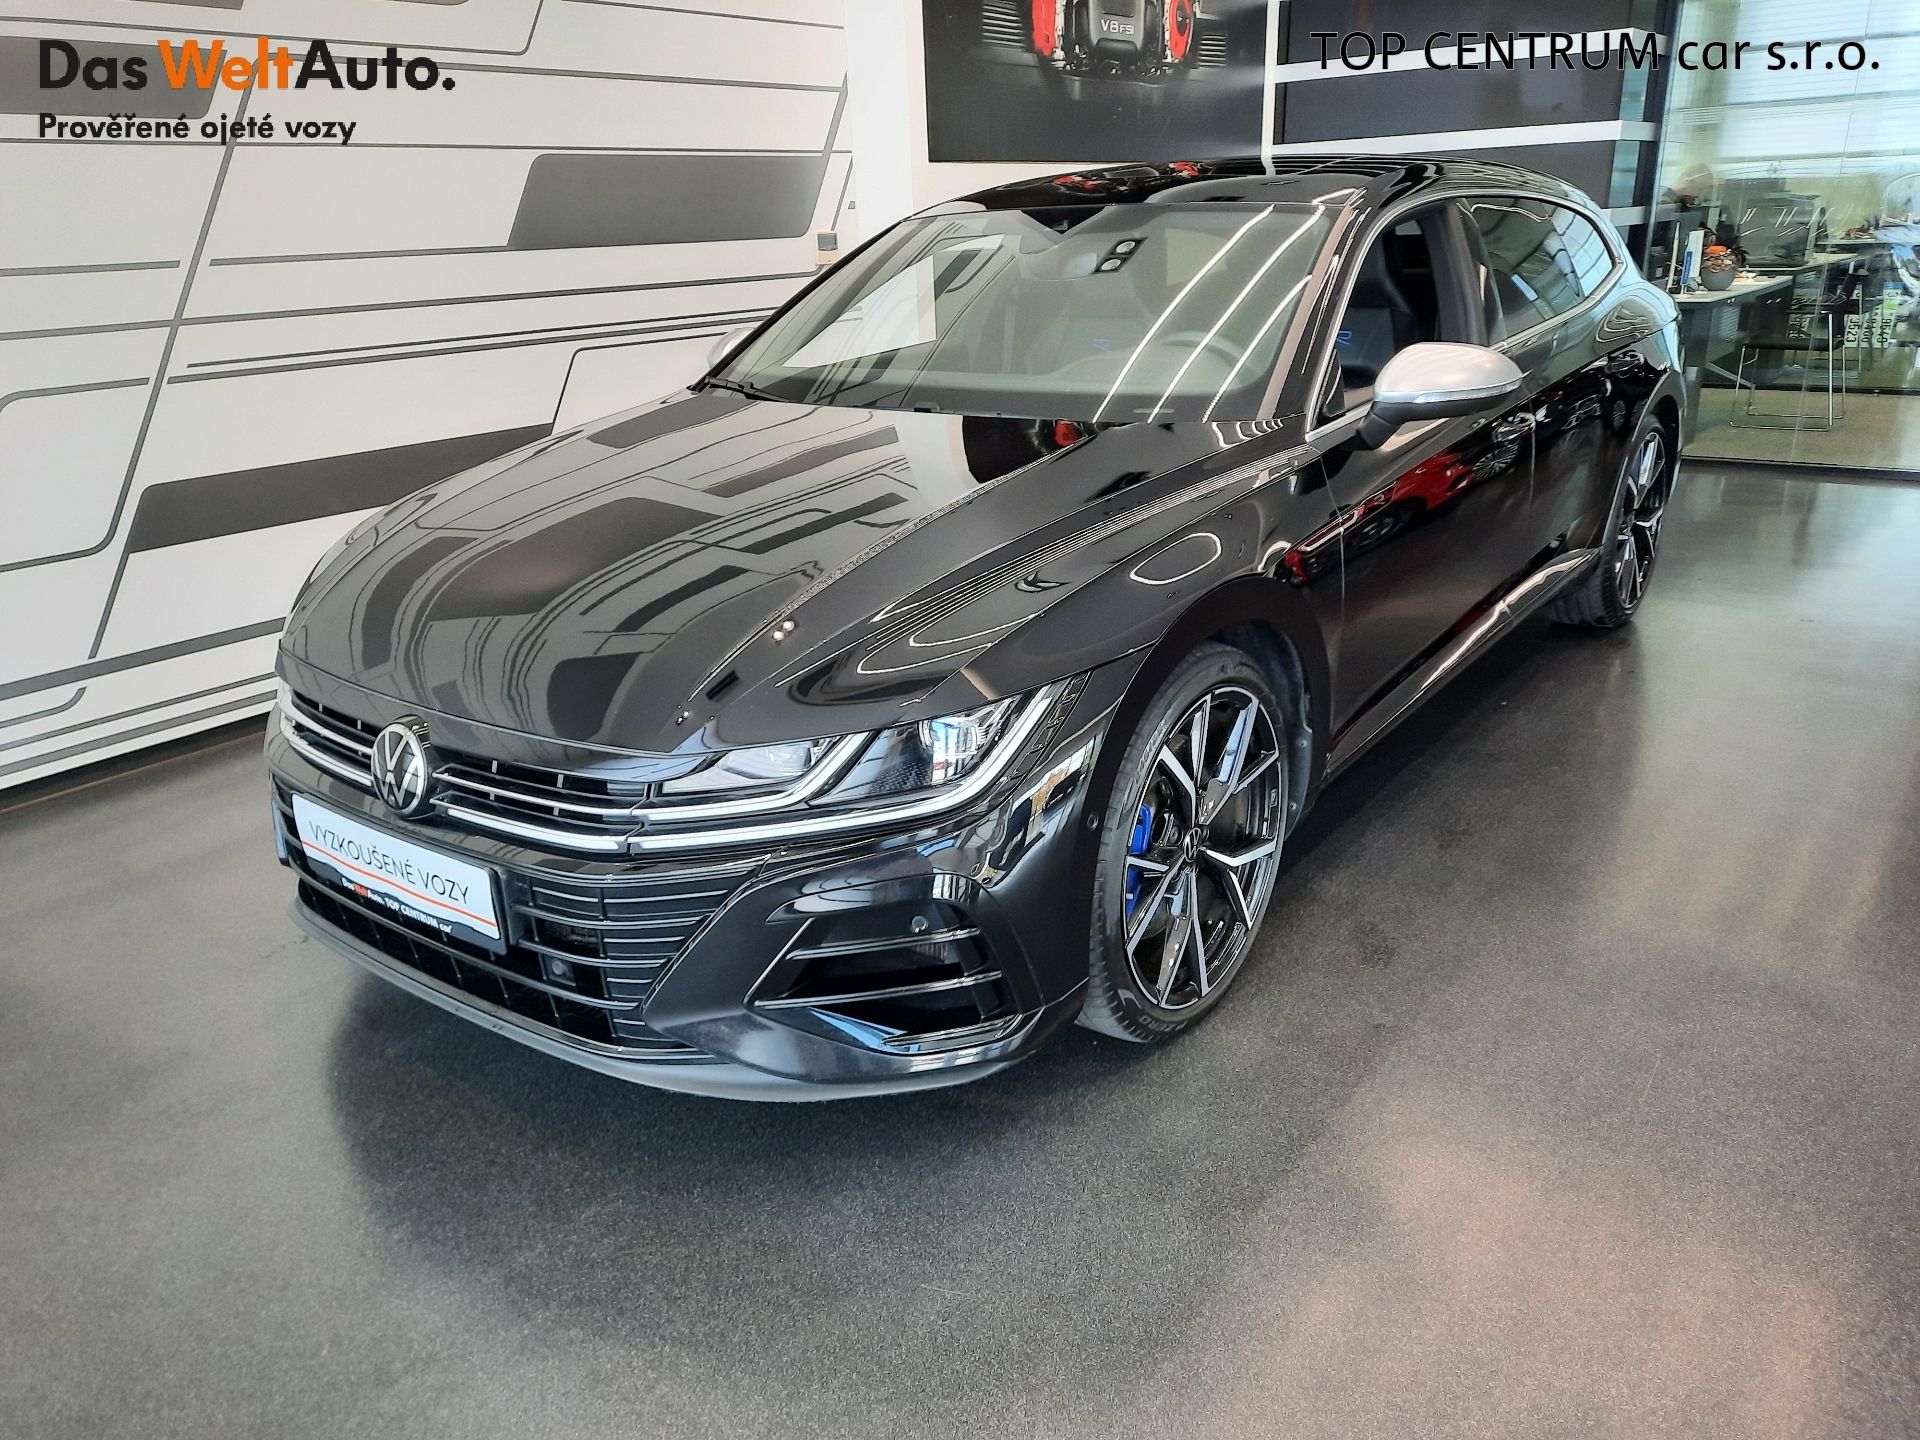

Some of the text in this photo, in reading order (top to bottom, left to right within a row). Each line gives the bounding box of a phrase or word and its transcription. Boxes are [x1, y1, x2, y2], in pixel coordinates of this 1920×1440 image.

[1100, 19, 1119, 33] V8
[308, 819, 470, 904] VYZKOUŠENÉ VOZY
